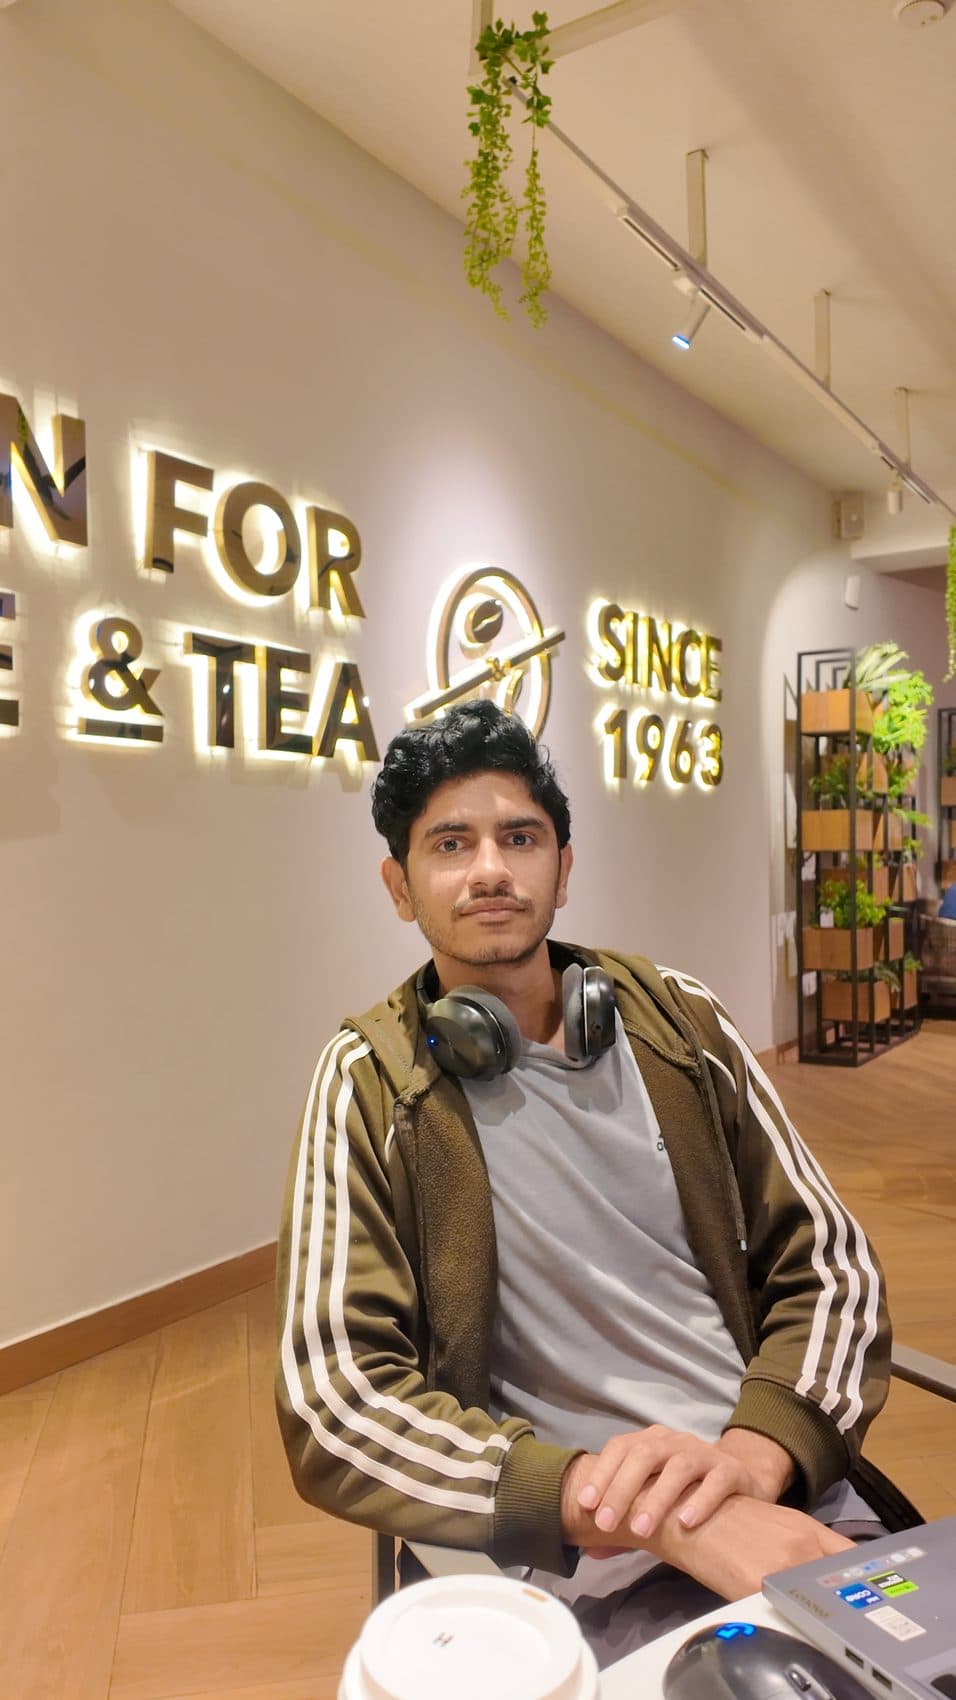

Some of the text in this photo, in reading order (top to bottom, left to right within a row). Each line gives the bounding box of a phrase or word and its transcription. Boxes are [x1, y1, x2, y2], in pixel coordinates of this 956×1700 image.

[144, 450, 366, 618] FOR
[81, 617, 164, 716] &
[184, 632, 381, 762] TEA
[597, 603, 722, 702] SINCE
[604, 710, 723, 786] 1963
